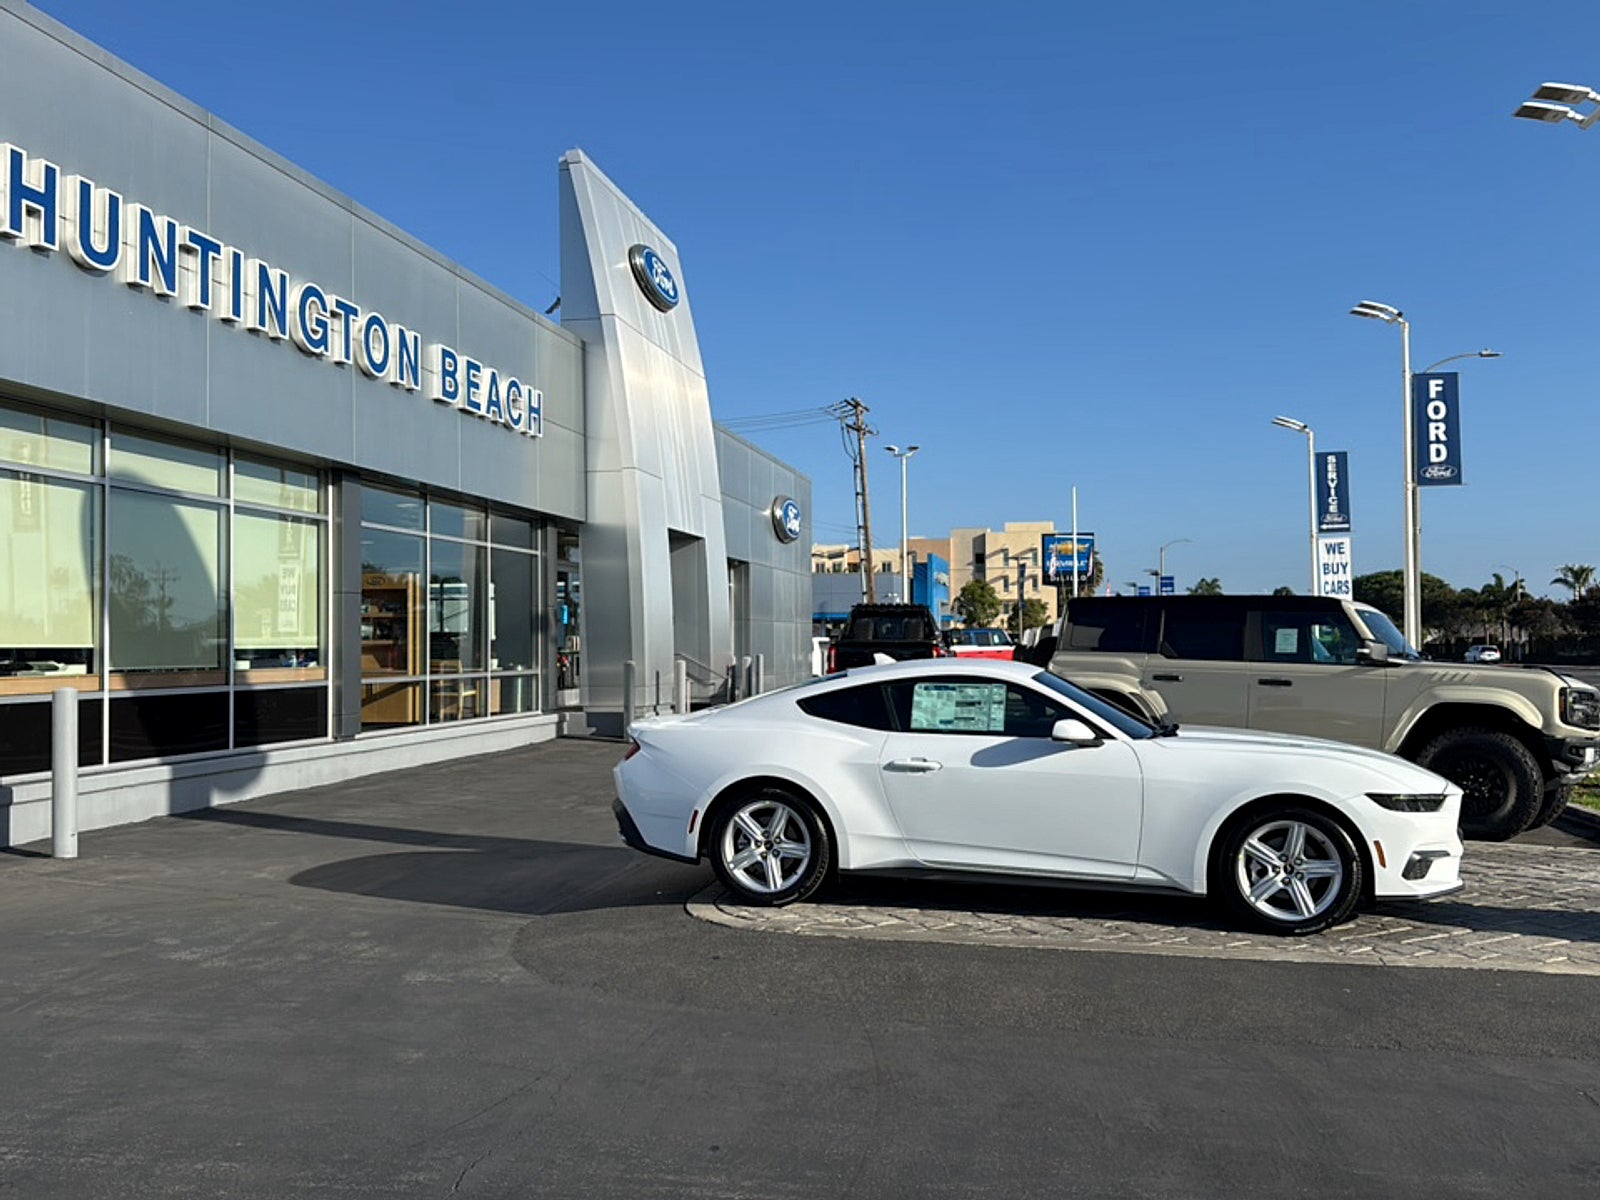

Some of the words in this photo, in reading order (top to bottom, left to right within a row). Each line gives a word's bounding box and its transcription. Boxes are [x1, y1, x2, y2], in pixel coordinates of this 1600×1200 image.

[1, 143, 421, 391] HUNTINGTON
[432, 344, 543, 438] BEACH
[649, 254, 677, 298] Ford
[1426, 379, 1447, 463] FORD
[1326, 454, 1338, 513] SERVICE
[1423, 465, 1455, 479] Ford
[1325, 542, 1345, 555] WE
[1323, 562, 1348, 575] BUY
[1323, 580, 1350, 595] CARS
